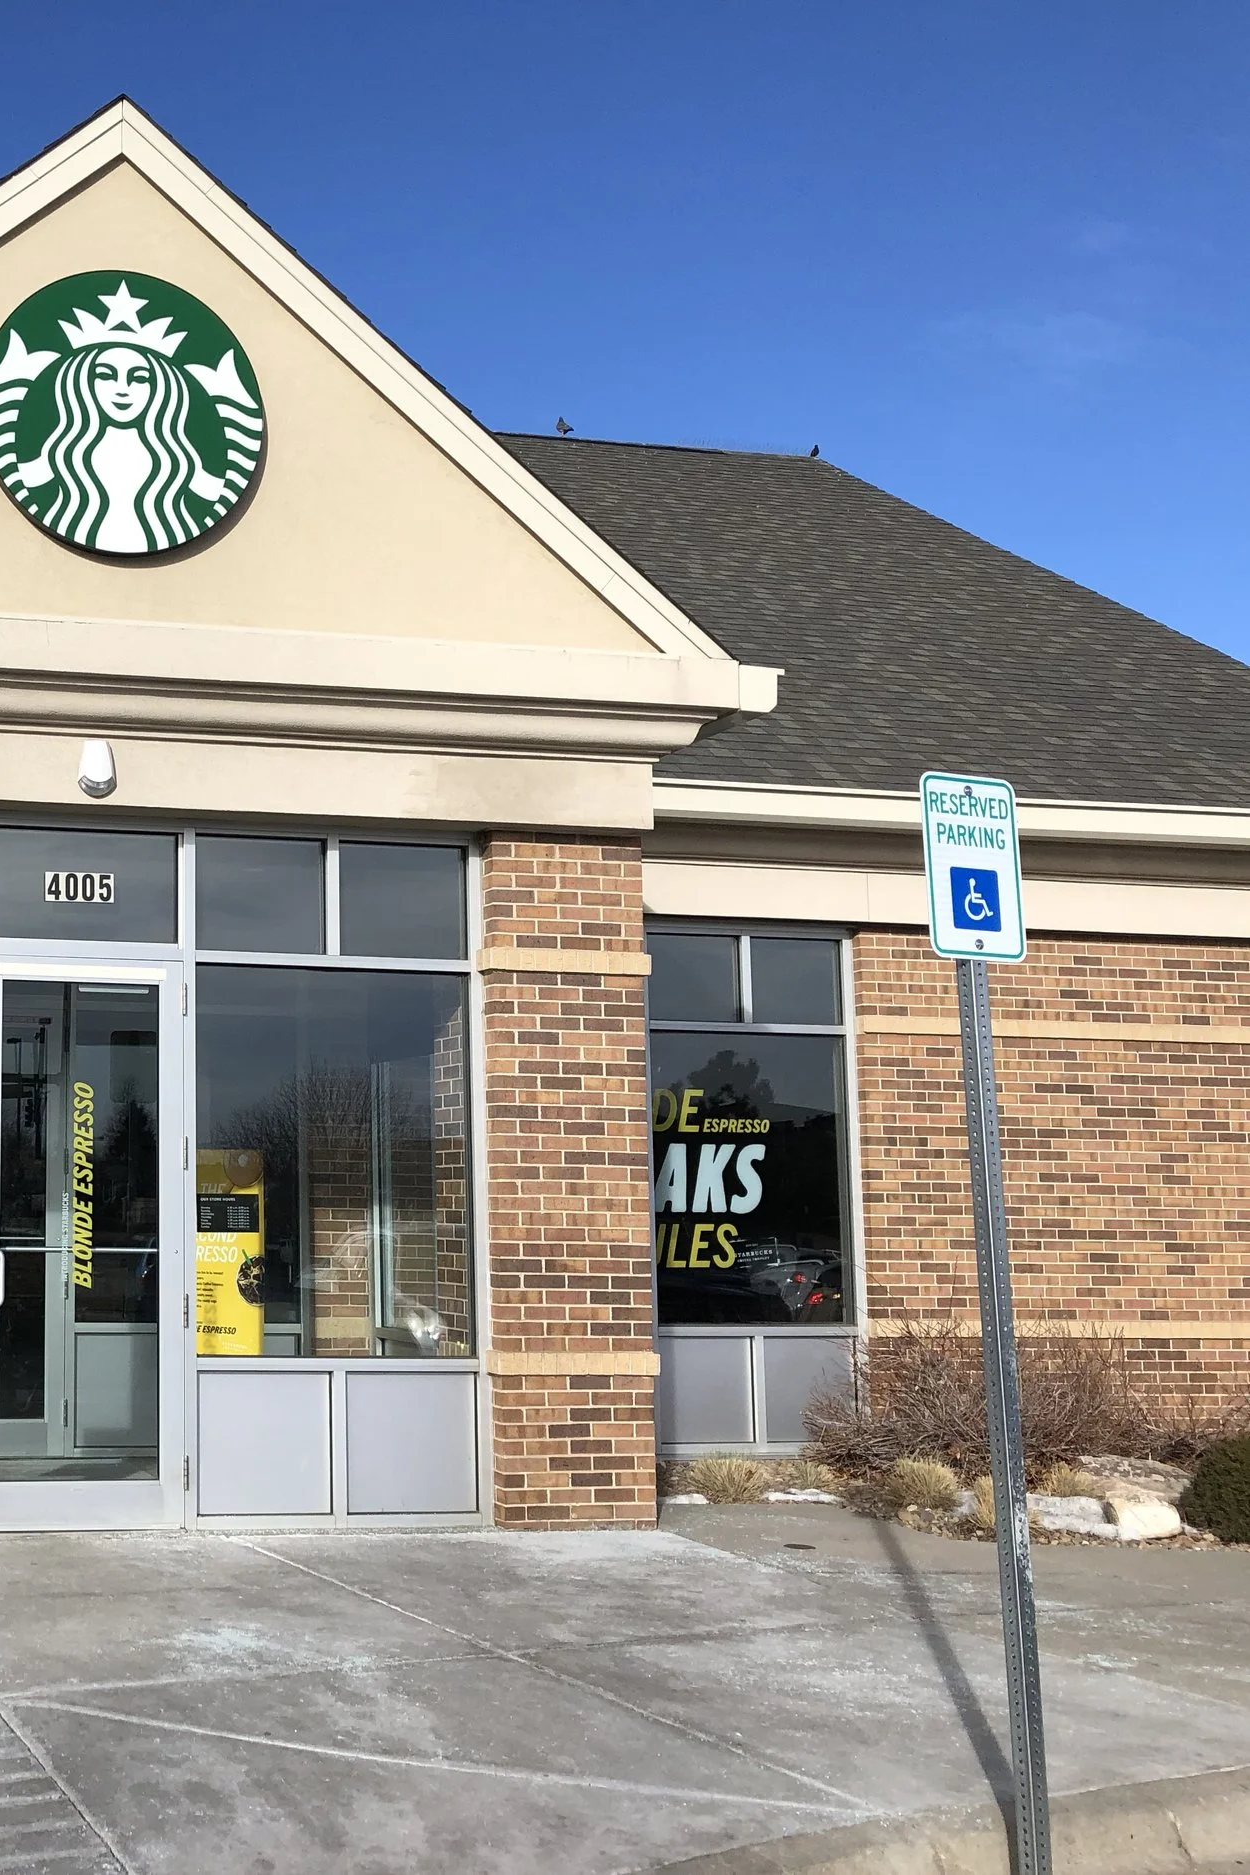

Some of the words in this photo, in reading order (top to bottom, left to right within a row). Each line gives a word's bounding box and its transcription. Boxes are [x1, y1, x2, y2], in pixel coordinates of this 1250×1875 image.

[929, 791, 1008, 820] RESERVED
[936, 822, 1005, 850] PARKING
[47, 873, 112, 902] 4005
[72, 1081, 95, 1196] ESPRESSO
[702, 1118, 770, 1134] ESPRESSO
[72, 1197, 94, 1289] BLONDE
[202, 1325, 237, 1335] ESPRESSO
